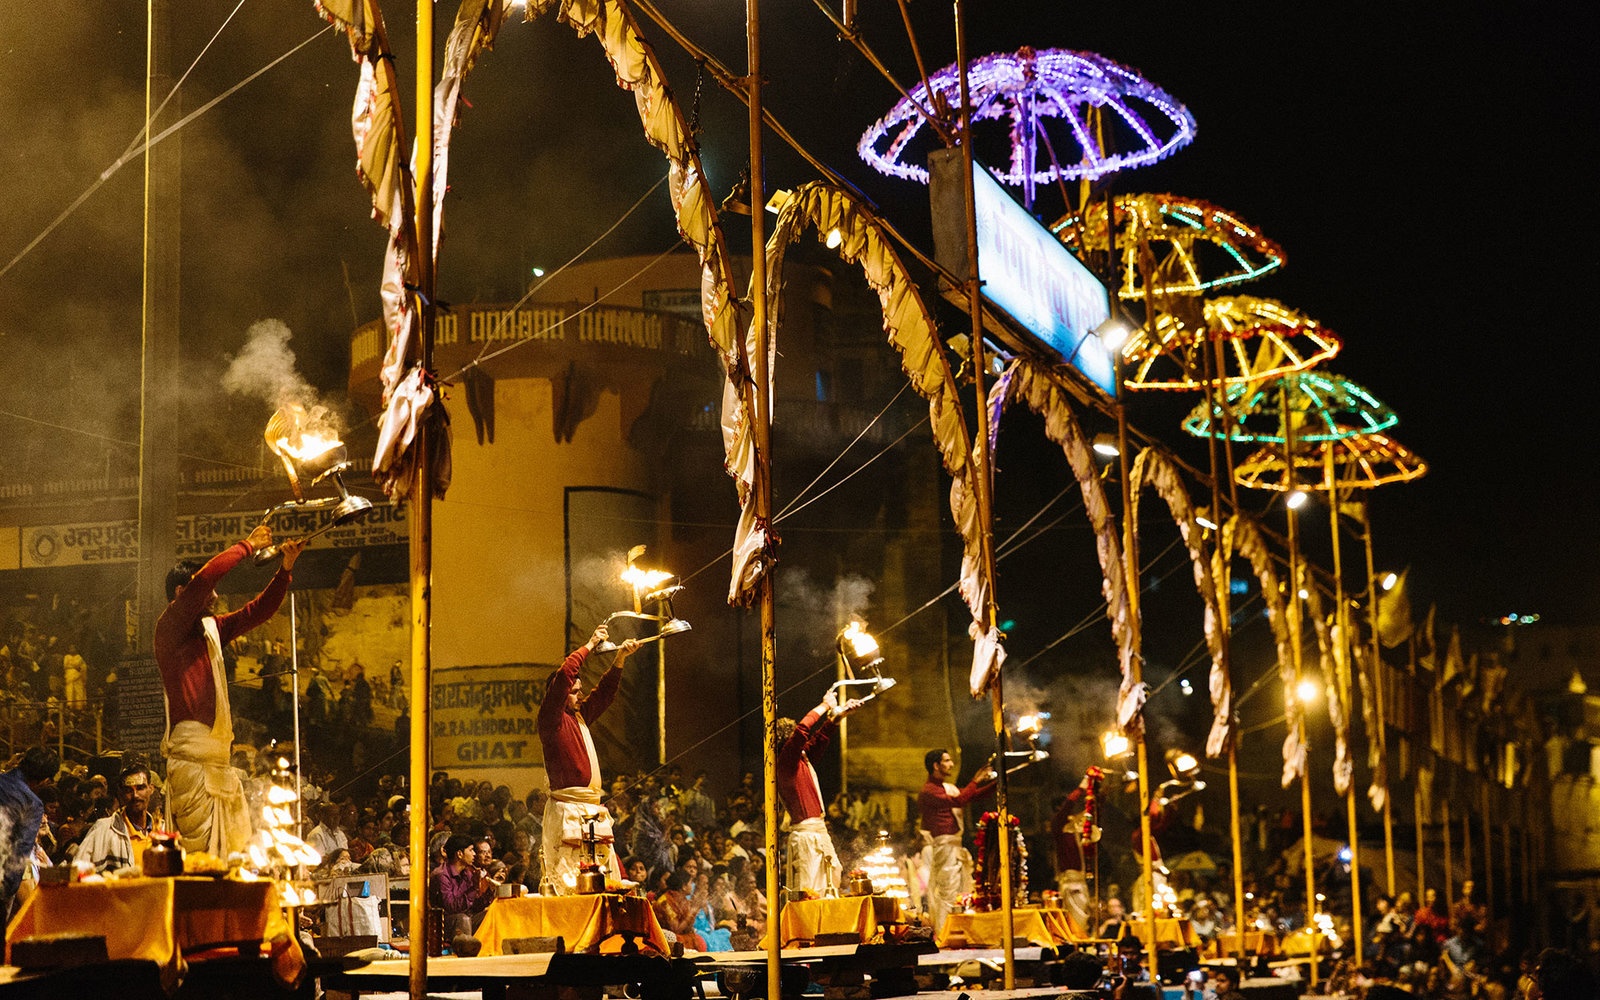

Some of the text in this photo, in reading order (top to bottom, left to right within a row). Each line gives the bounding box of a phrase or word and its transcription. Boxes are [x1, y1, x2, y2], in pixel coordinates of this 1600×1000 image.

[993, 201, 1033, 296] गंगा
[1036, 235, 1073, 331] सेवा
[176, 516, 191, 540] ल
[194, 514, 242, 538] निगम
[367, 503, 406, 524] घाट
[457, 740, 528, 762] GHAT
